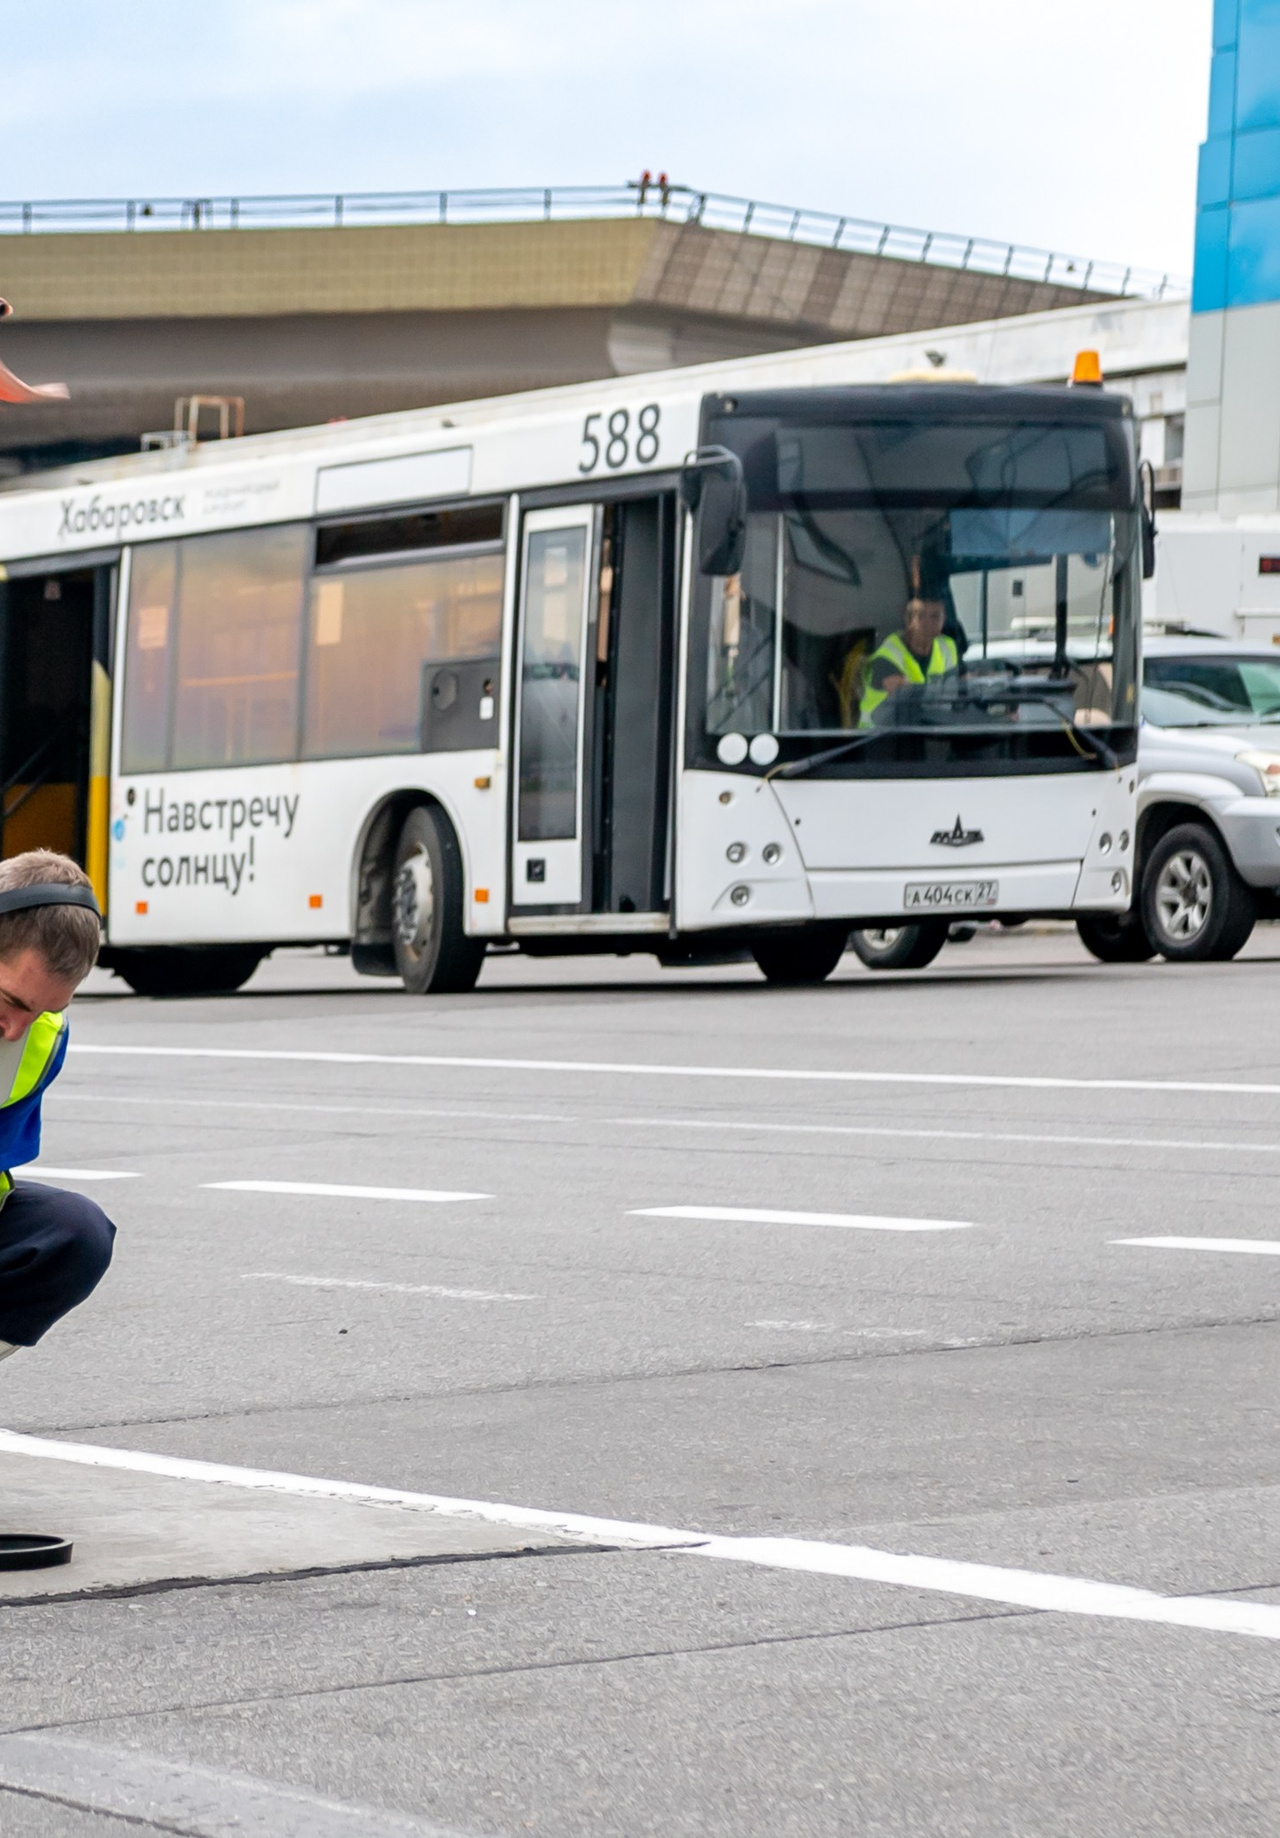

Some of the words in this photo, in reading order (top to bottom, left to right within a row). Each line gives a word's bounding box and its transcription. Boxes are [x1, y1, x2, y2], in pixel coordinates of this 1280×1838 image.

[578, 402, 660, 473] 588
[58, 494, 186, 539] Хабаровск
[144, 787, 300, 842] Навстречу
[141, 836, 254, 896] солнцу!
